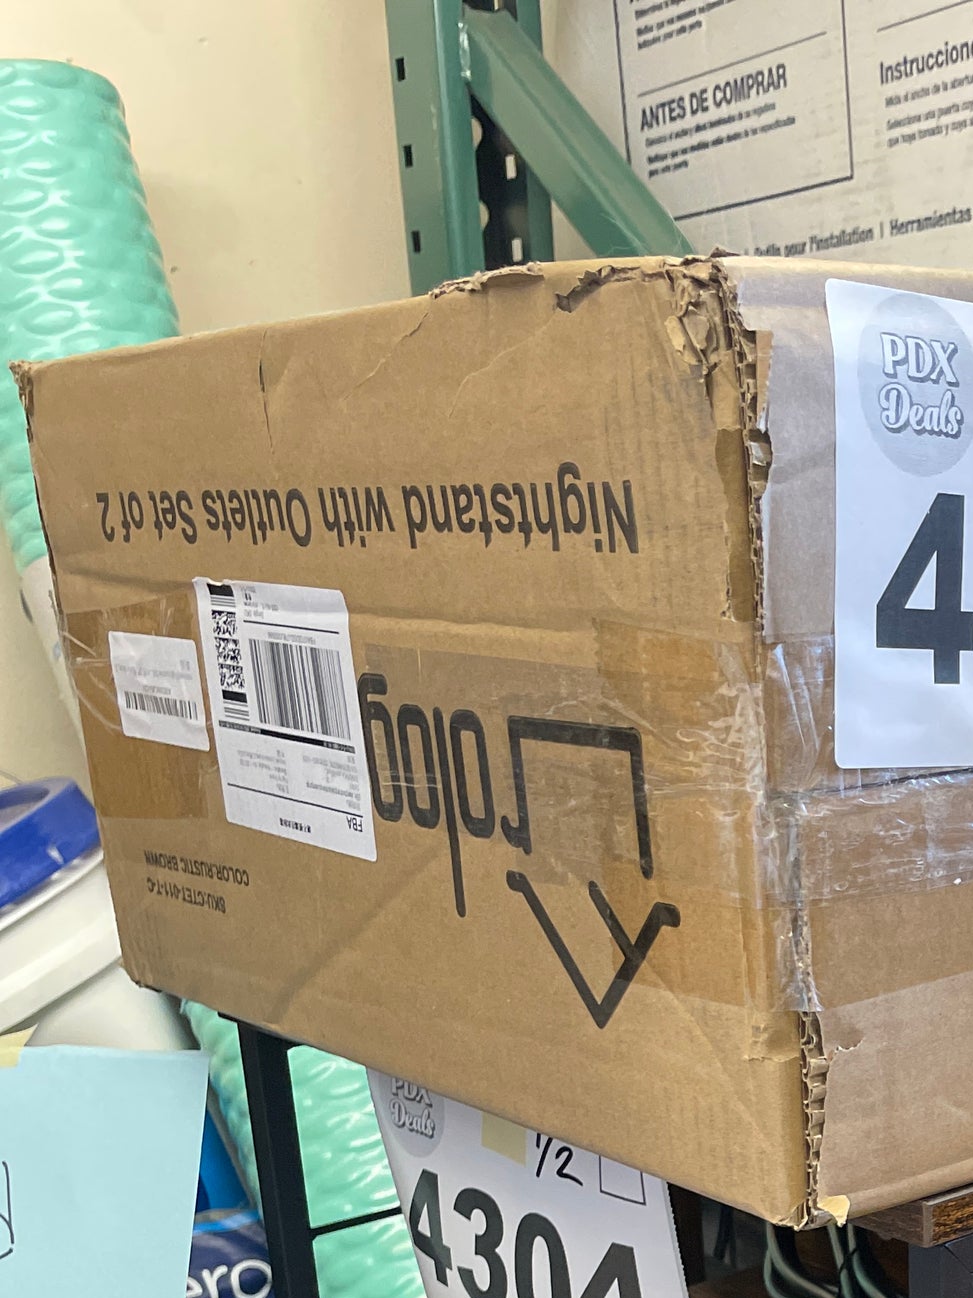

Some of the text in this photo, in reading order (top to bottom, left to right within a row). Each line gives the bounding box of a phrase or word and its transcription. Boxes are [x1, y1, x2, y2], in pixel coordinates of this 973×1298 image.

[640, 96, 686, 132] ANTES
[689, 88, 709, 117] DE
[712, 63, 788, 109] COMPRAR
[889, 207, 972, 237] Herramientas
[879, 332, 959, 387] PDX
[877, 384, 965, 440] Deals
[96, 462, 640, 555] Nightstand with Outlets Set of 2
[346, 815, 363, 832] FBA
[144, 849, 179, 872] BROWN
[389, 1098, 436, 1139] Deals
